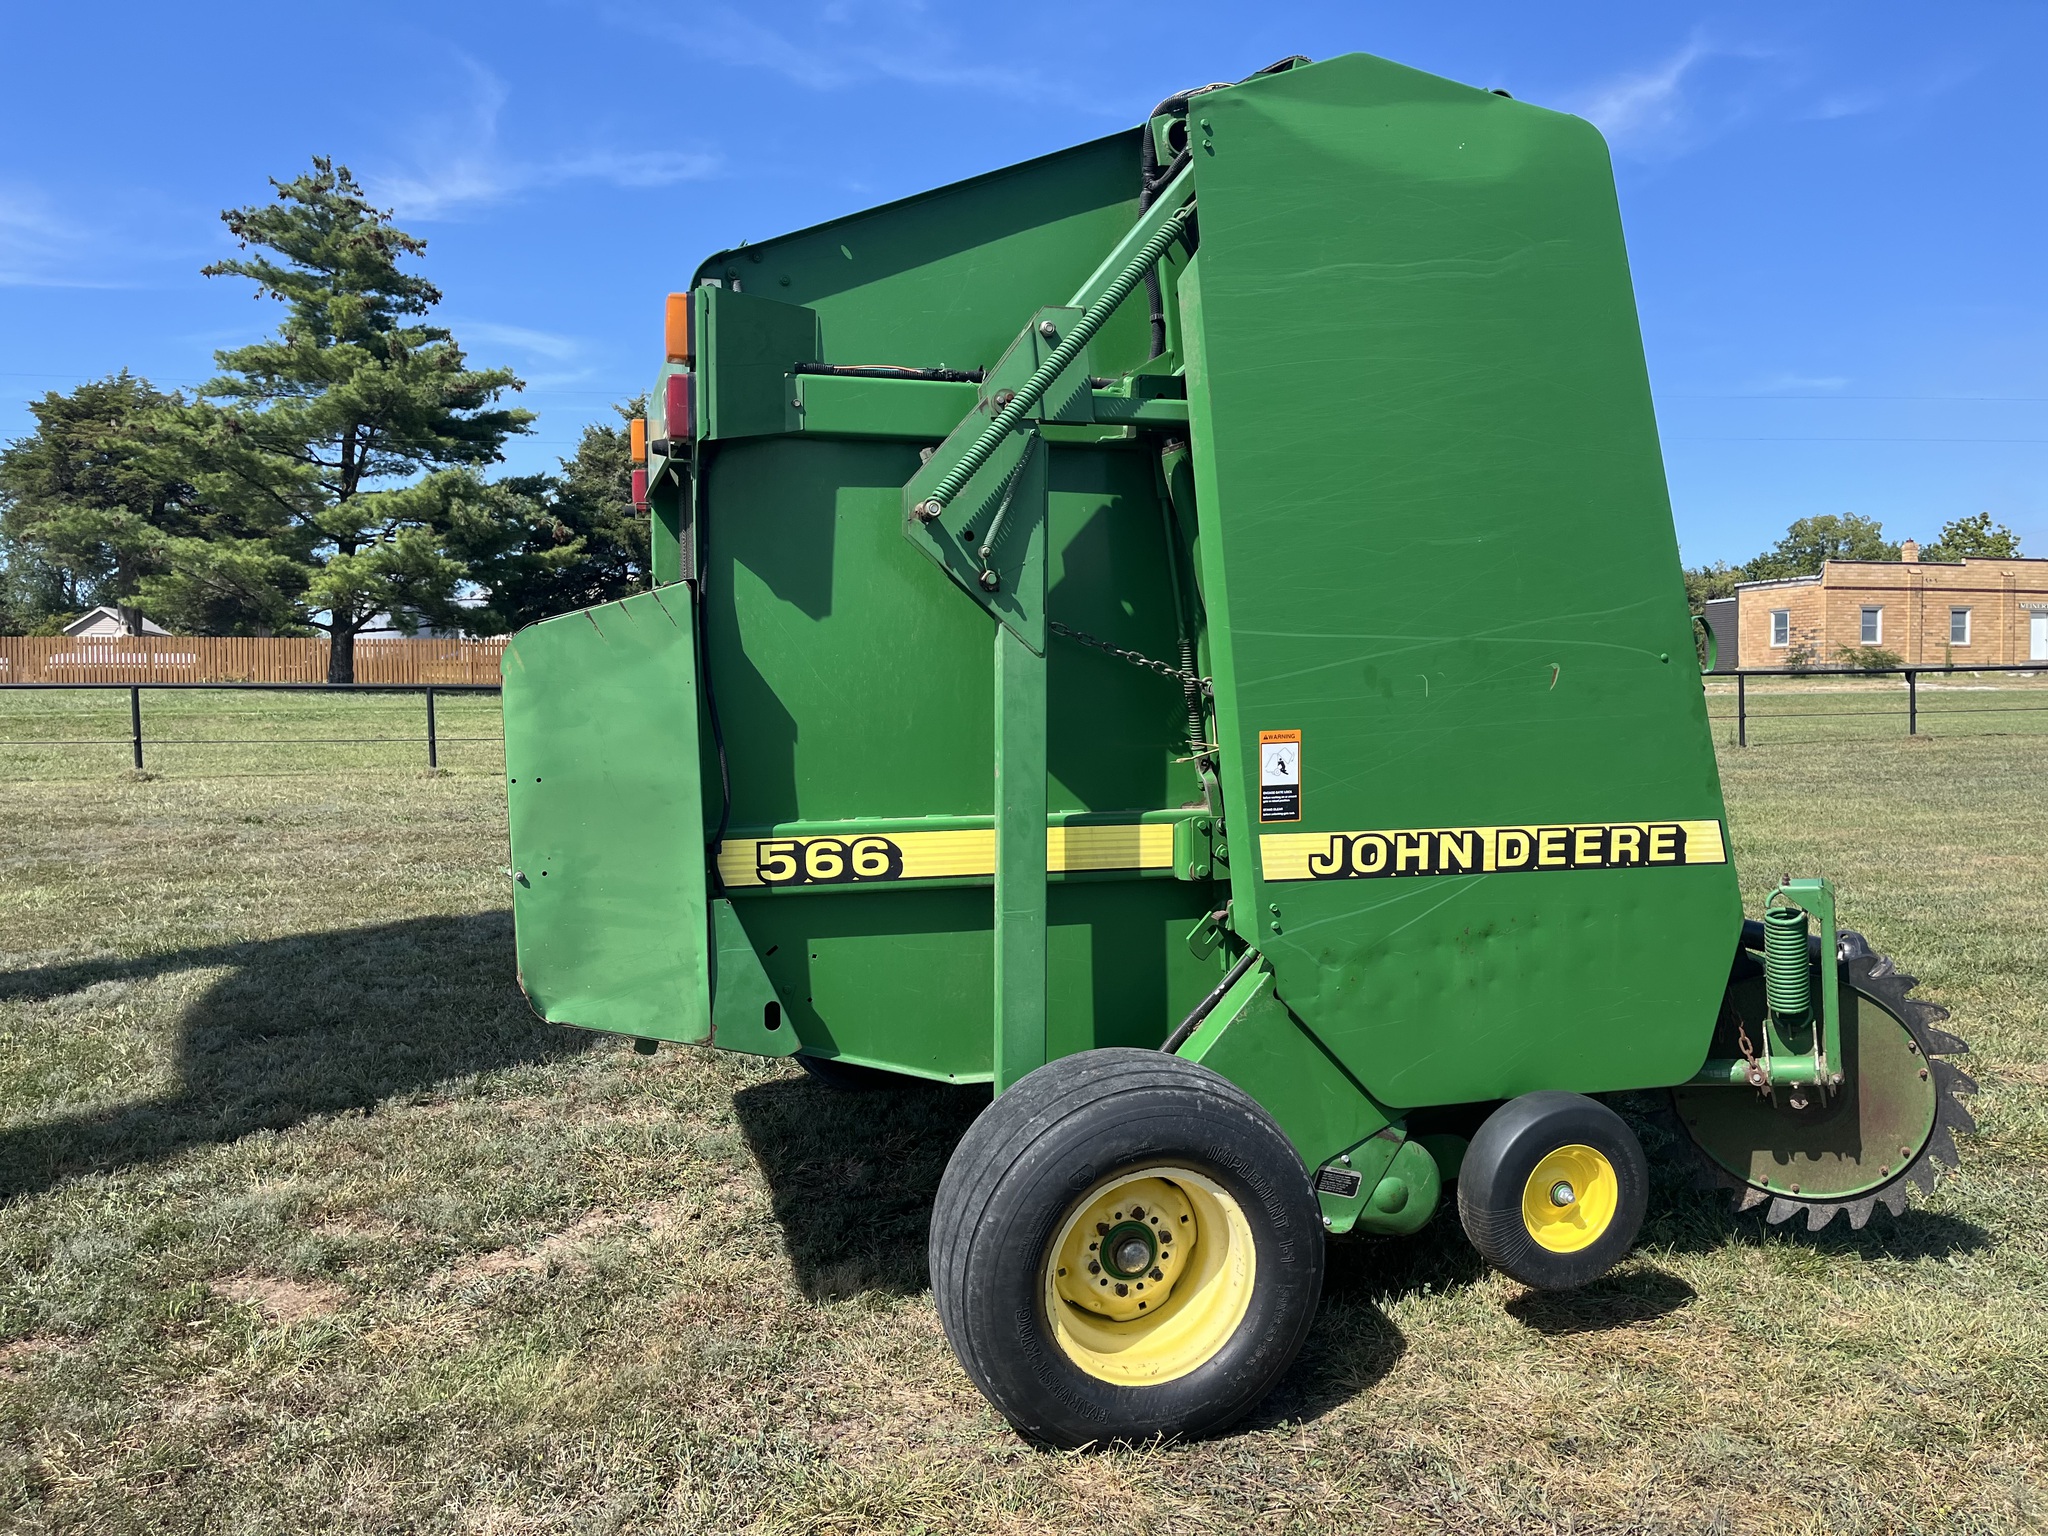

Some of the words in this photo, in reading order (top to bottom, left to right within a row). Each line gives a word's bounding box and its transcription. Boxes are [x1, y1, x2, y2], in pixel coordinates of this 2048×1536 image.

[756, 837, 902, 884] 566
[1309, 831, 1482, 877] JOHN
[1495, 825, 1685, 870] DEERE
[1207, 1145, 1290, 1229] IMPLEMENT
[1015, 1307, 1041, 1361] KING
[1034, 1361, 1111, 1424] HARVEST
